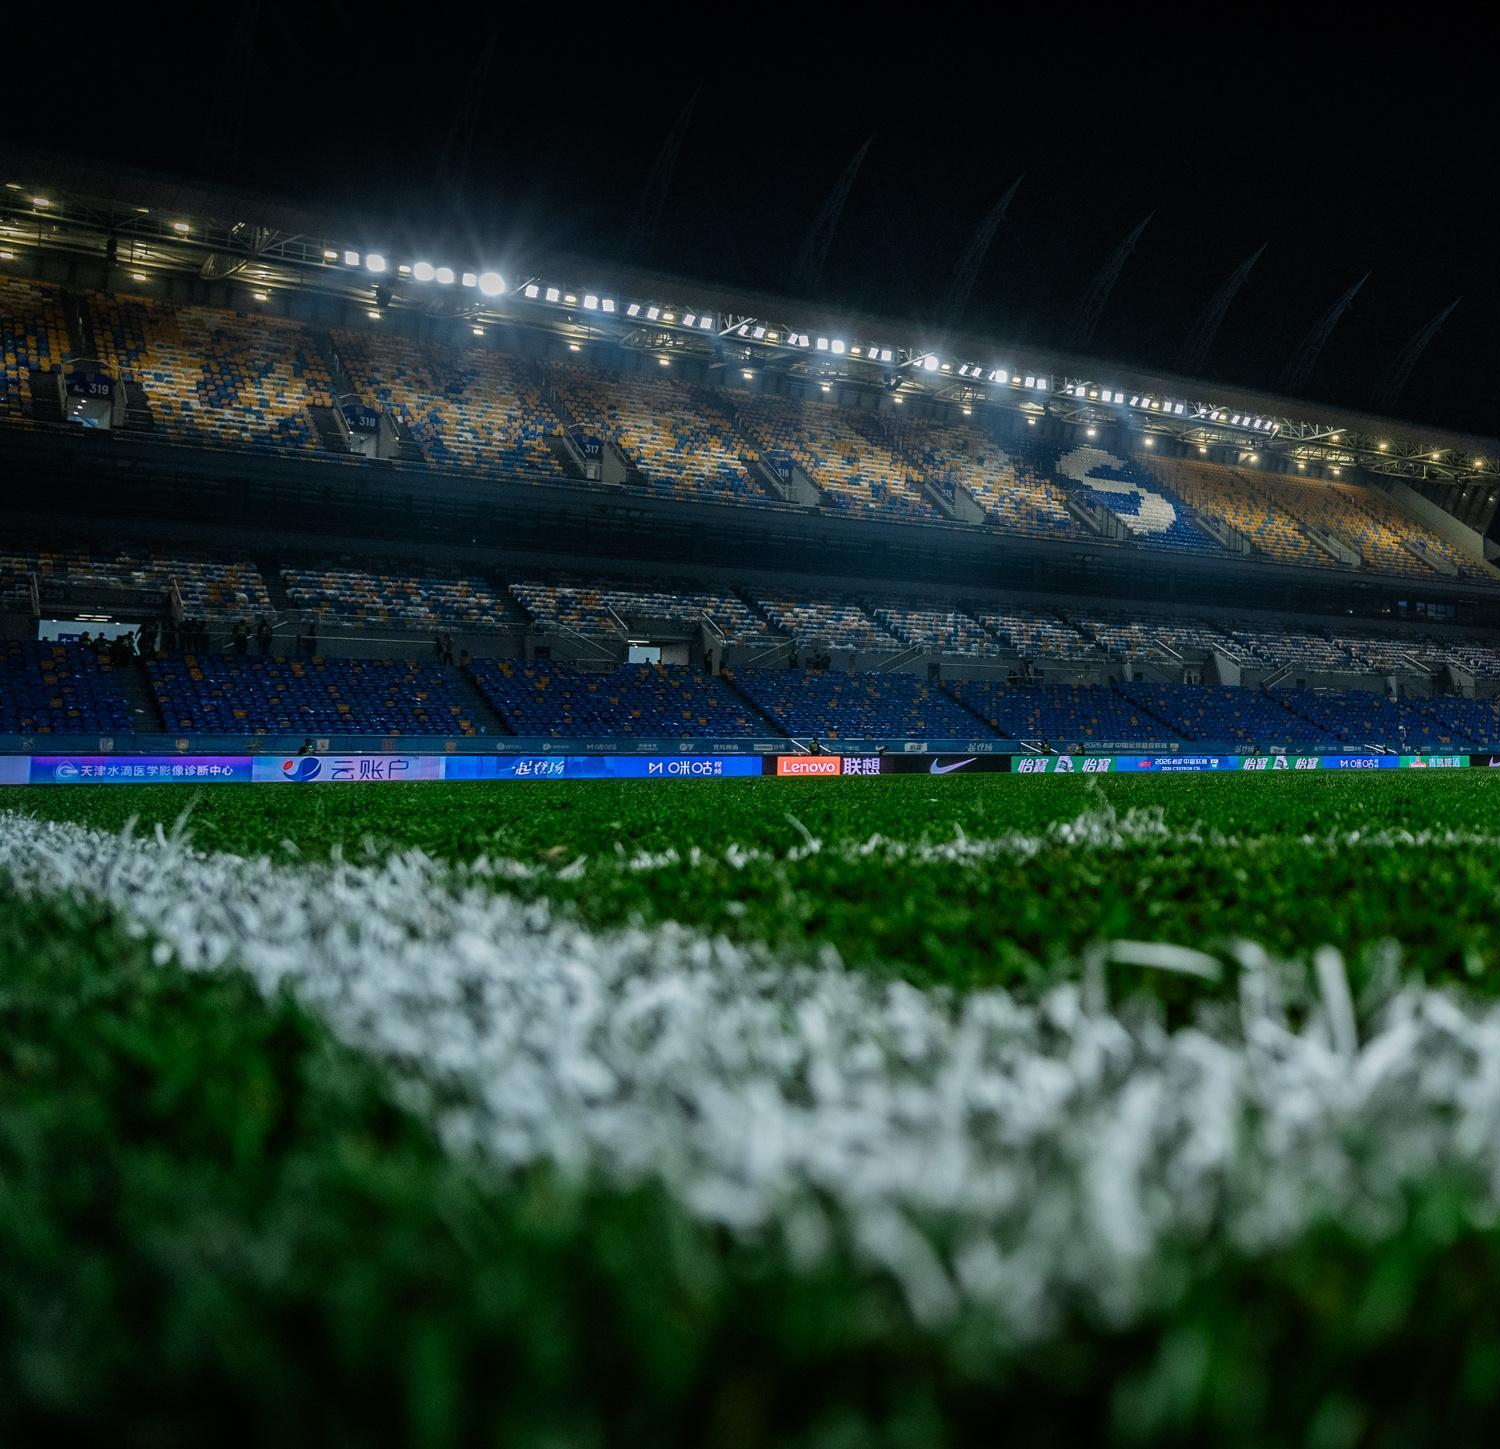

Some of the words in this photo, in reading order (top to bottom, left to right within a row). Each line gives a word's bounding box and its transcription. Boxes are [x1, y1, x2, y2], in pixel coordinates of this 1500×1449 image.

[89, 384, 109, 394] 319
[359, 417, 376, 427] 318
[585, 445, 599, 454] 317
[82, 765, 233, 777] 天津水滴医学影像诊断中心
[331, 759, 409, 780] 云账户
[783, 761, 835, 773] Lenovo
[842, 758, 880, 775] 联想
